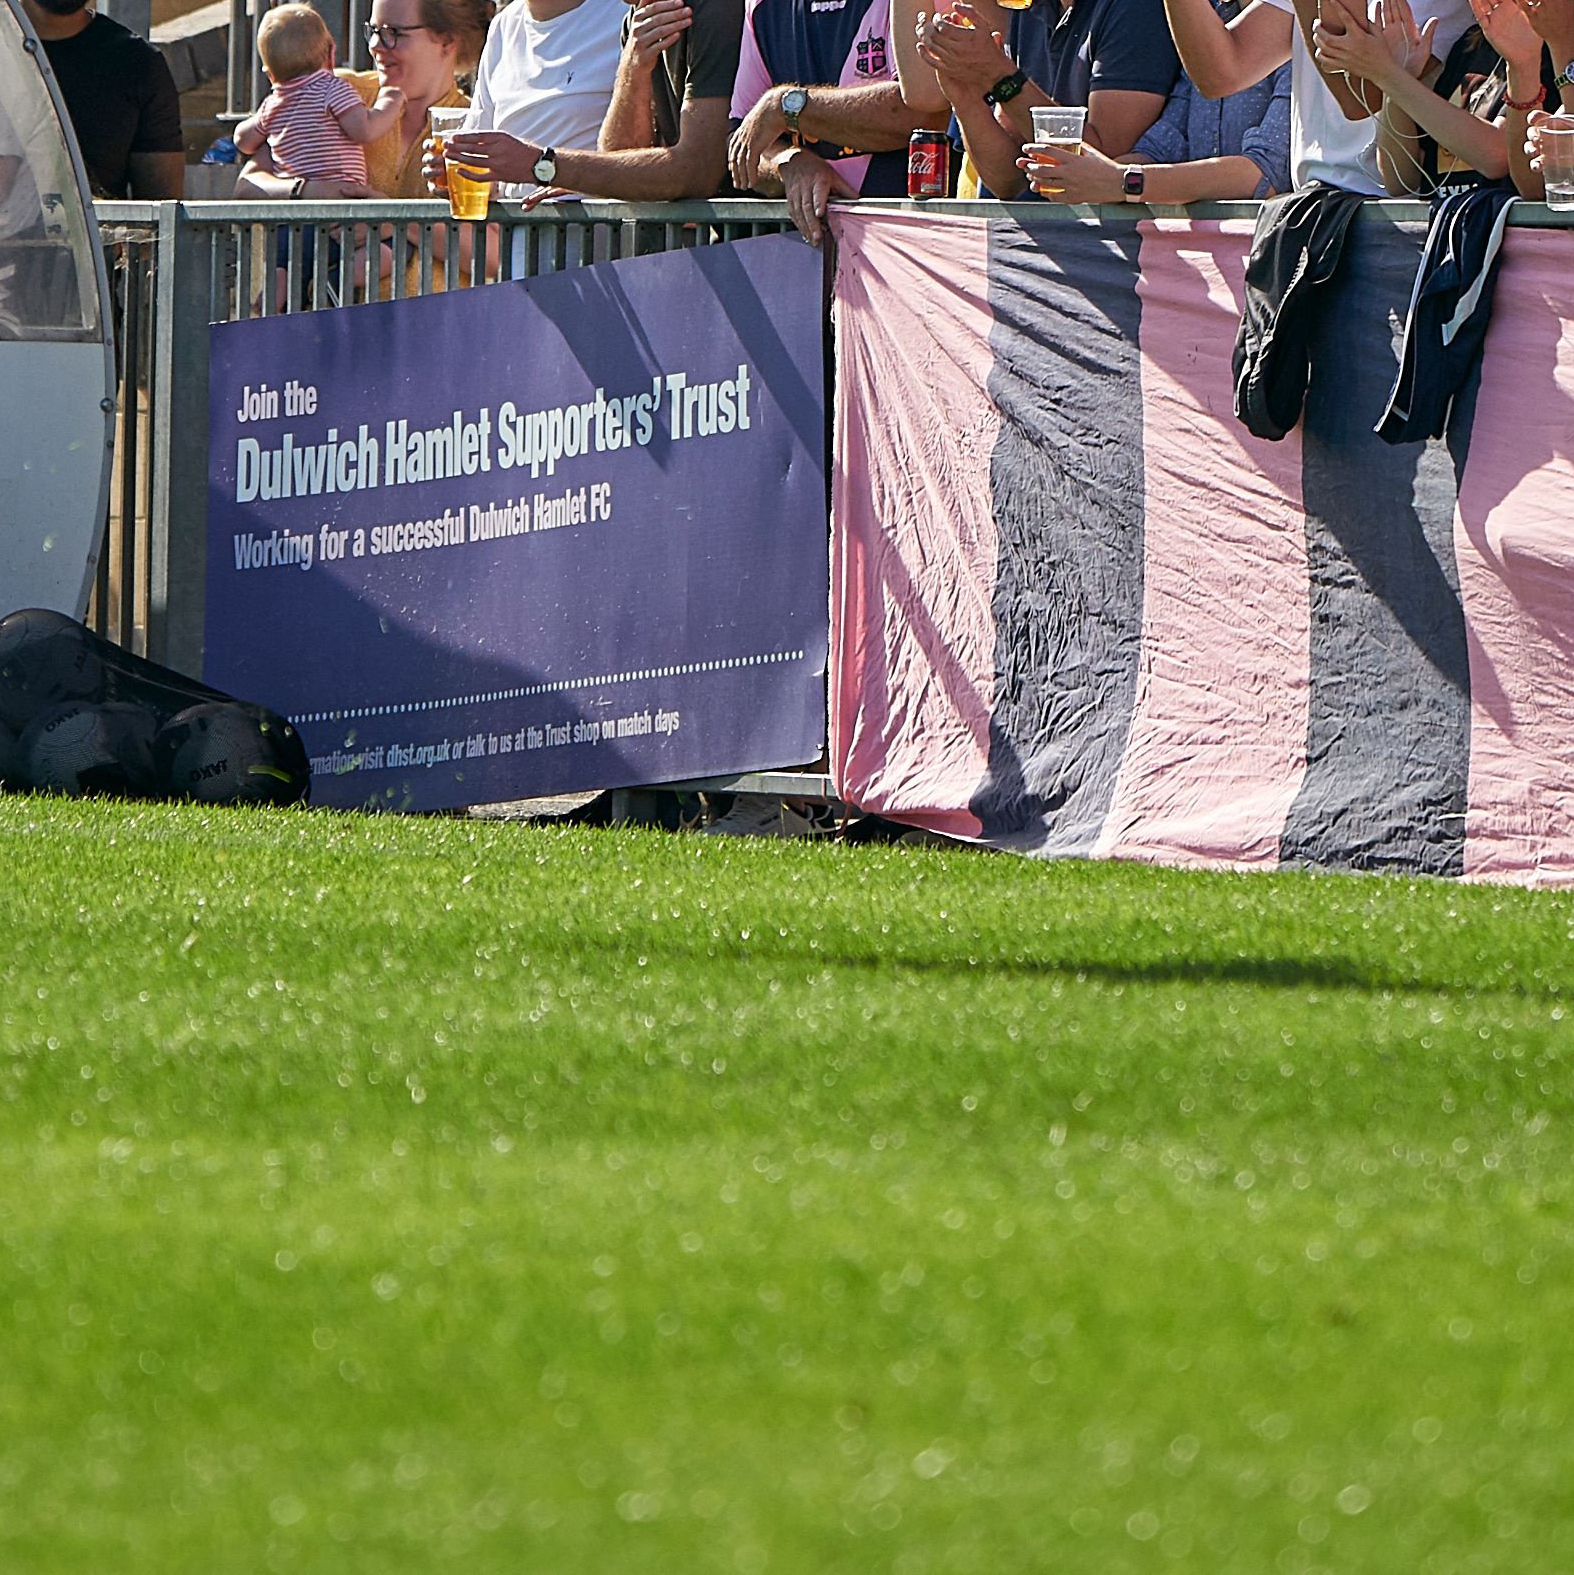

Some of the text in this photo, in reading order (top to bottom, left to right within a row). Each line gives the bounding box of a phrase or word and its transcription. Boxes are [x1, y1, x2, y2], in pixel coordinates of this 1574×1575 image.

[236, 425, 378, 503] Dulwich
[384, 408, 491, 486] Hamlet
[666, 364, 751, 440] Trust
[237, 380, 317, 423] Join the
[234, 482, 612, 571] Working for a successful Dulwich Hamlet FC
[386, 738, 450, 768] dhst.org.uk
[452, 740, 464, 759] or
[465, 733, 486, 758] talk
[487, 732, 498, 755] to
[499, 731, 513, 753] us
[514, 728, 527, 751] at
[527, 726, 544, 748] the
[545, 721, 572, 747] Trust
[574, 719, 599, 746] shop
[601, 720, 615, 739] on
[617, 709, 652, 738] match
[654, 708, 681, 737] days
